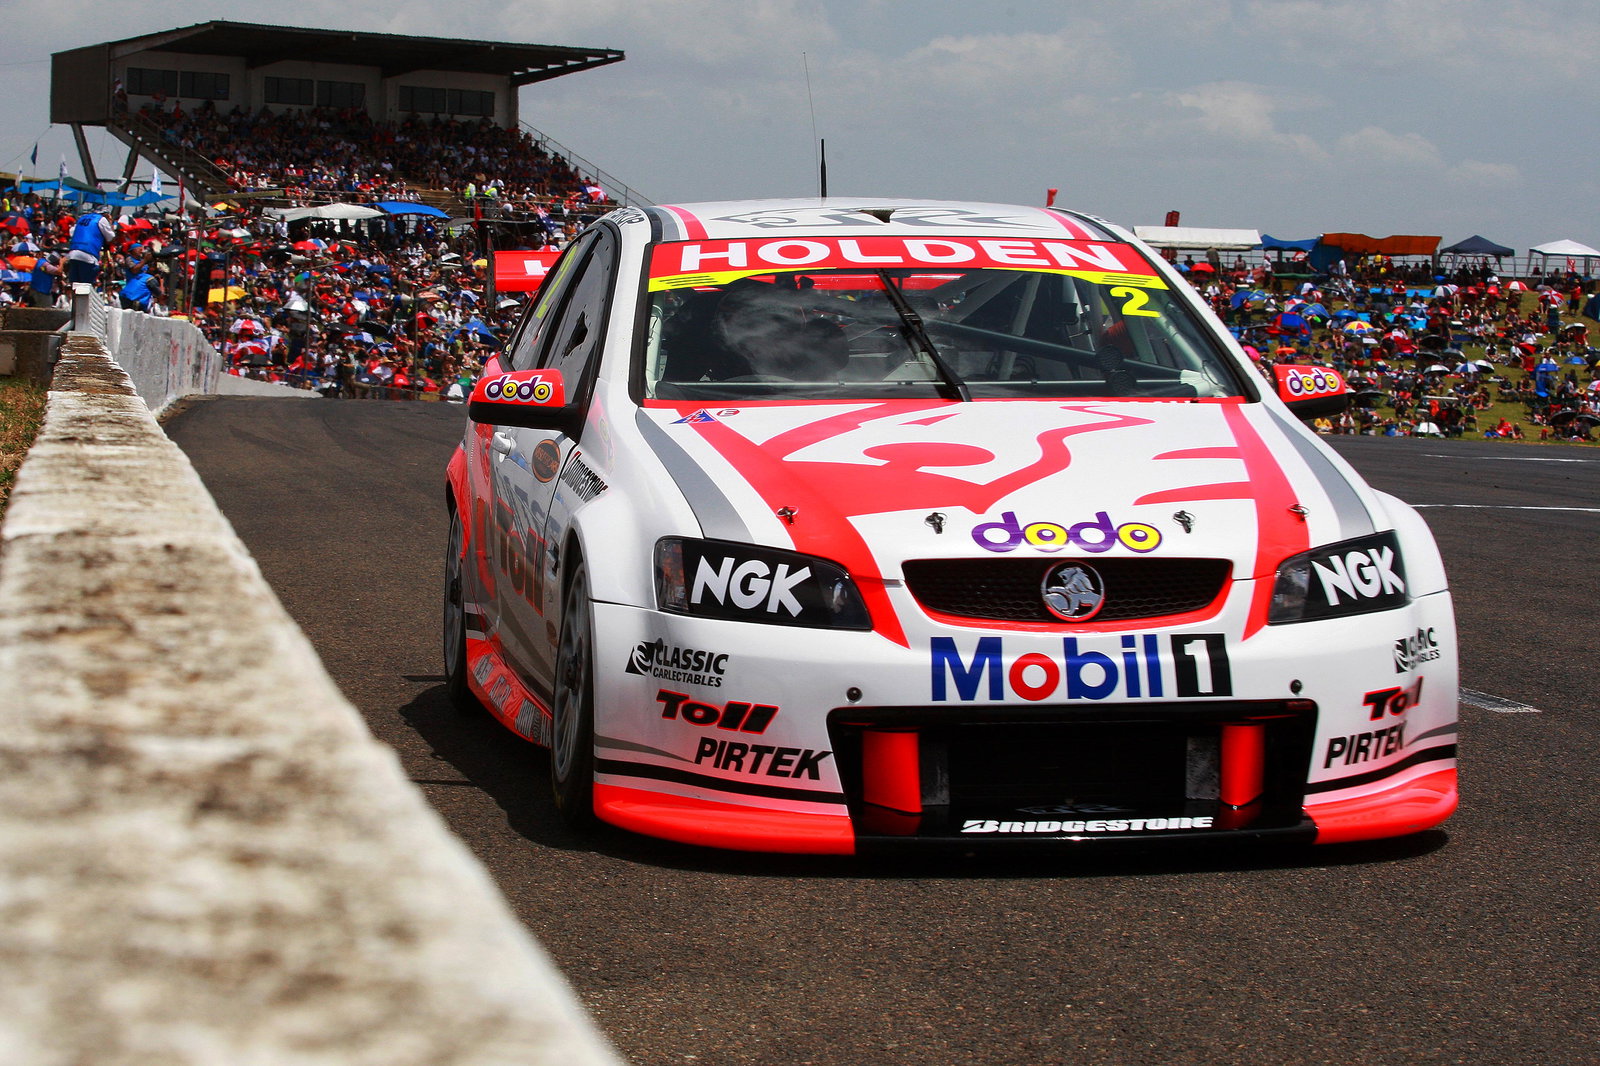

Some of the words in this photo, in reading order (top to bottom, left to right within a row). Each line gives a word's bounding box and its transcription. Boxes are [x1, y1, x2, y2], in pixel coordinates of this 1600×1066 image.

[680, 237, 1128, 273] HOLDEN
[1109, 286, 1160, 318] 2
[484, 374, 554, 403] dodo
[1286, 366, 1342, 396] dodo
[560, 450, 609, 504] BRIDGESTONE
[971, 511, 1162, 554] dodo
[690, 555, 813, 618] NGK
[1311, 544, 1405, 607] NGK
[653, 667, 722, 688] CARLECTABLES
[655, 644, 729, 675] CLASSIC
[931, 633, 1163, 702] Mobil
[656, 688, 779, 735] Toll
[1362, 676, 1424, 721] Tol
[694, 736, 833, 781] PIRTEK
[1323, 719, 1408, 769] PIRTEK
[961, 816, 1214, 833] BRIDGESTONE
